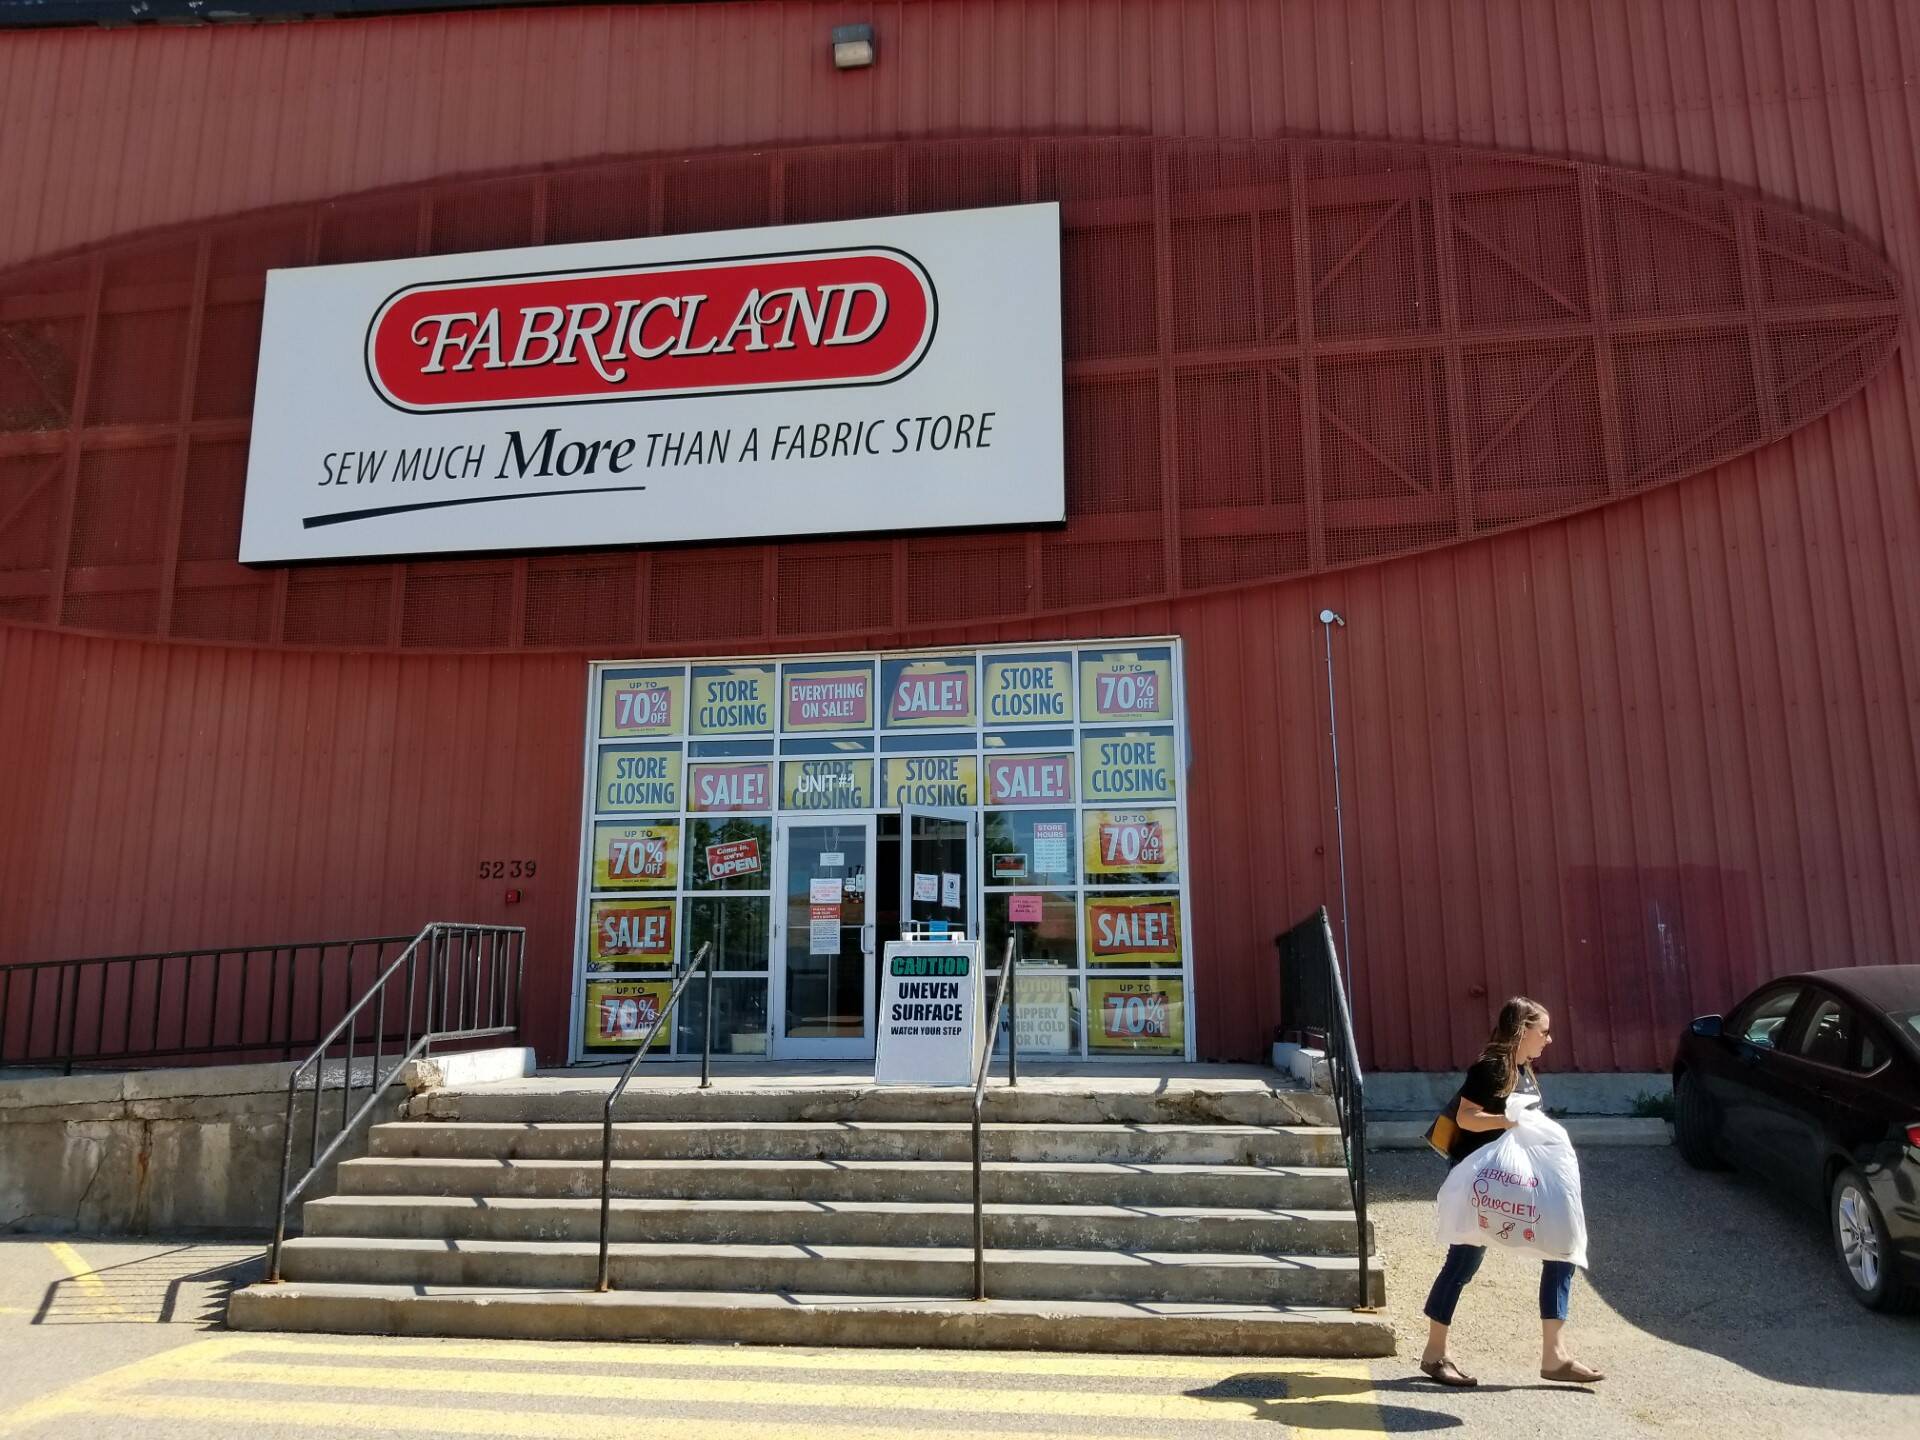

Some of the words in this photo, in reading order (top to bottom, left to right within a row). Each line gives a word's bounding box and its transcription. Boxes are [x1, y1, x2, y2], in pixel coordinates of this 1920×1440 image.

[411, 282, 888, 384] FABRICLAND
[319, 450, 387, 486] SEW
[394, 444, 486, 484] MUCH
[495, 428, 637, 481] More
[645, 429, 733, 469] THAN
[739, 428, 762, 464] A
[771, 420, 886, 460] FABRIC
[892, 412, 997, 452] STORE
[1000, 667, 1054, 690] STORE
[1111, 664, 1125, 673] UP
[1128, 664, 1142, 672] TO
[629, 682, 642, 690] UP
[644, 681, 657, 689] TO
[708, 679, 758, 703] STORE
[791, 682, 864, 702] EVERYTHING
[898, 680, 963, 713] SALE!
[1101, 676, 1155, 709] 70%
[619, 692, 667, 725] 70%
[802, 702, 819, 718] ON
[821, 701, 854, 717] SALE!
[991, 693, 1064, 717] CLOSING
[1137, 697, 1154, 709] OFF
[651, 713, 667, 725] OFF
[700, 704, 767, 728] CLOSING
[1100, 742, 1156, 765] STORE
[617, 757, 667, 779] STORE
[905, 759, 959, 781] STORE
[700, 774, 764, 806] SALE!
[798, 775, 837, 793] UNIT
[839, 773, 855, 791] #1
[996, 765, 1063, 798] SALE!
[1092, 768, 1167, 793] CLOSING
[607, 783, 675, 805] CLOSING
[792, 787, 862, 809] CLOSING
[897, 784, 967, 807] CLOSING
[1114, 815, 1128, 823] UP
[1131, 815, 1146, 823] TO
[624, 830, 637, 838] UP
[640, 829, 653, 837] TO
[1104, 827, 1159, 862] 70%
[613, 841, 664, 875] 70%
[712, 856, 757, 876] OPEN
[1142, 849, 1160, 861] OFF
[480, 860, 536, 879] 5239
[645, 863, 662, 875] OFF
[603, 915, 666, 948] SALE!
[1098, 912, 1168, 948] SALE!
[892, 957, 968, 975] CAUTION
[899, 982, 958, 999] UNEVEN
[892, 1003, 962, 1021] SURFACE
[1108, 997, 1164, 1033] 70%
[891, 1026, 919, 1035] WATCH
[921, 1026, 941, 1035] YOUR
[943, 1026, 962, 1035] STEP
[1146, 1021, 1165, 1033] OFF
